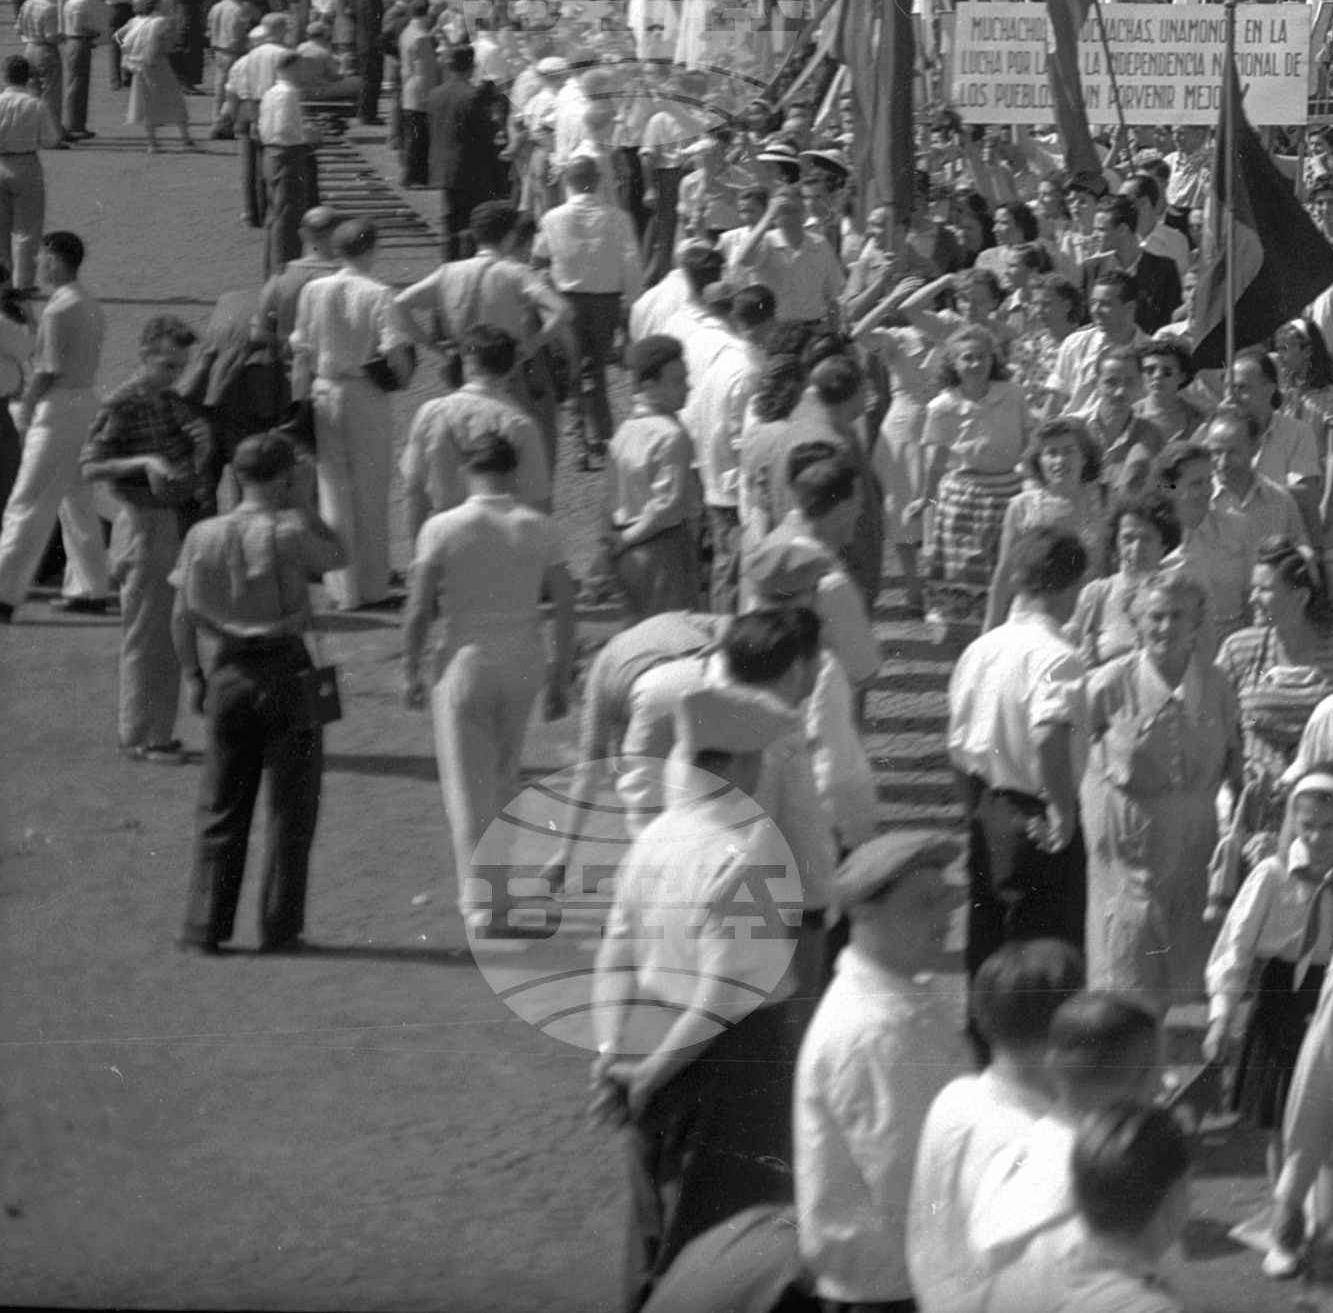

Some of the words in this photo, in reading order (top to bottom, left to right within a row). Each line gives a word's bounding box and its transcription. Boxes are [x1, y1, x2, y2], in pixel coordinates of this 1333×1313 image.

[972, 17, 1048, 41] MUCHACHO
[1160, 19, 1236, 43] UNAMONO
[1244, 19, 1262, 43] EN
[1270, 19, 1288, 43] LA
[962, 50, 1002, 75] LUCHA
[1008, 51, 1031, 75] POR
[1285, 52, 1302, 77] DE
[960, 83, 987, 107] LOS
[995, 83, 1054, 108] PUEBLO
[1184, 85, 1222, 110] MEJO
